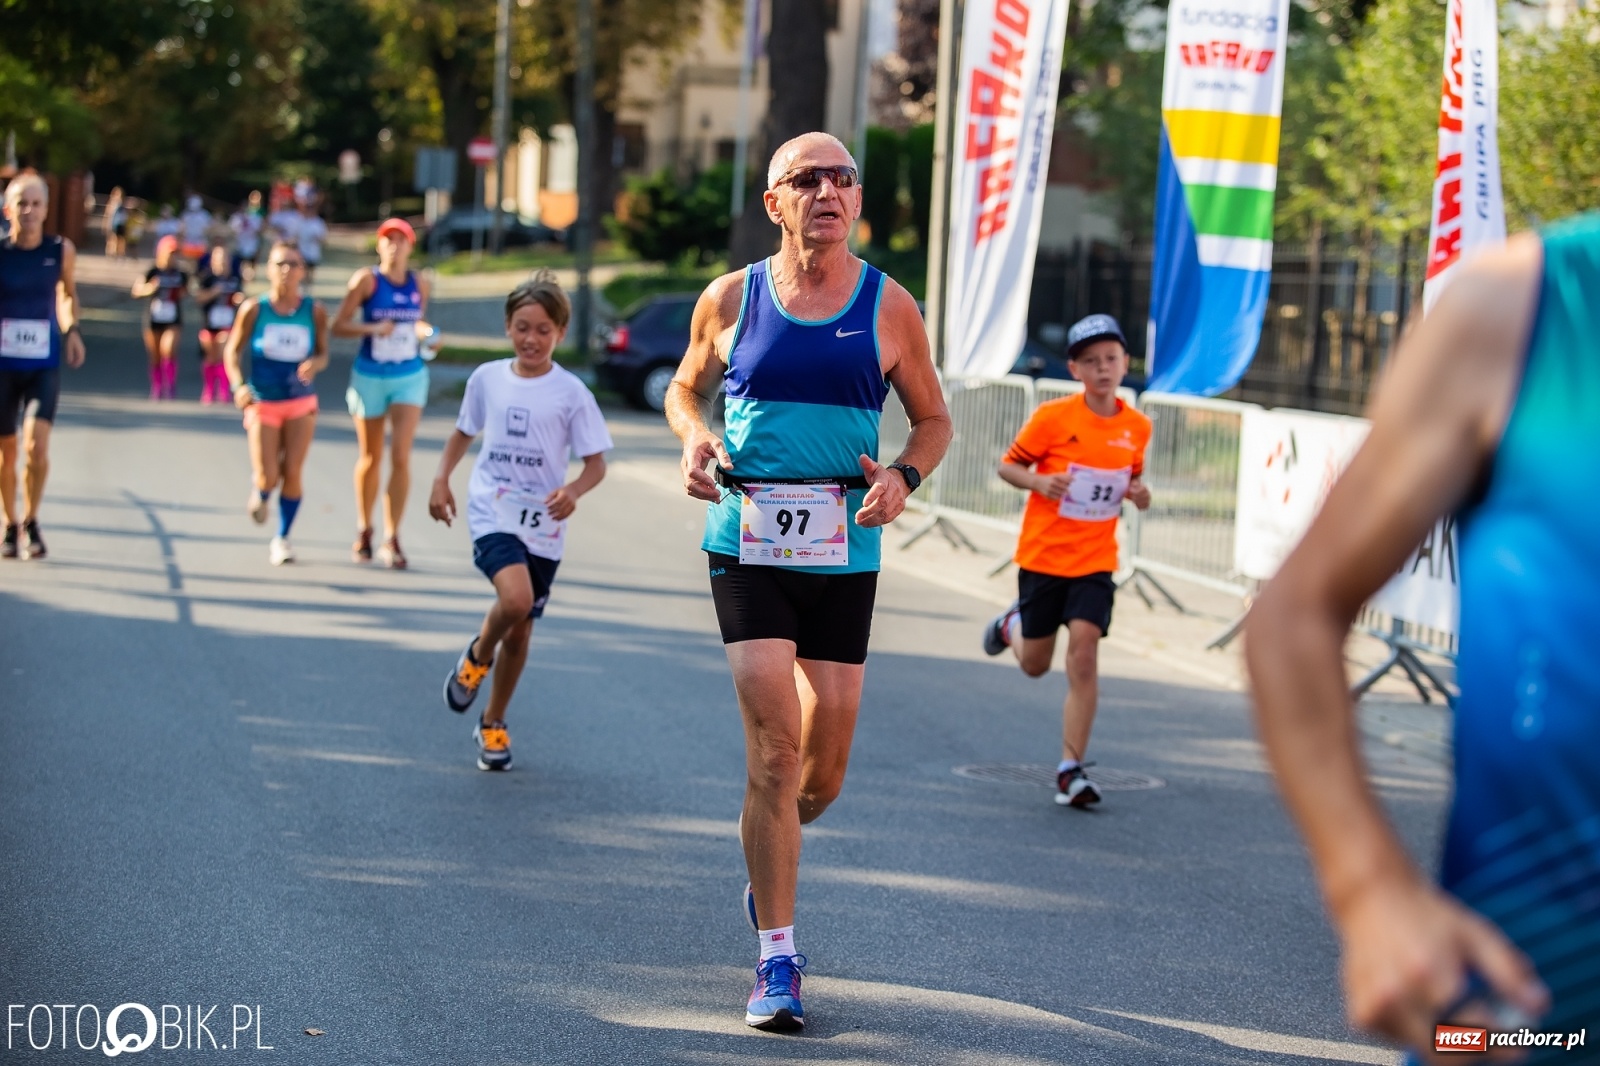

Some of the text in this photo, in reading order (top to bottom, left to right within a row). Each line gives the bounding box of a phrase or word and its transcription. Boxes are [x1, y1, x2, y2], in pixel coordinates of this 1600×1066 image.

[489, 451, 543, 467] RUN KIDS
[1091, 485, 1113, 500] 32
[519, 508, 542, 527] 15
[776, 508, 811, 537] 97
